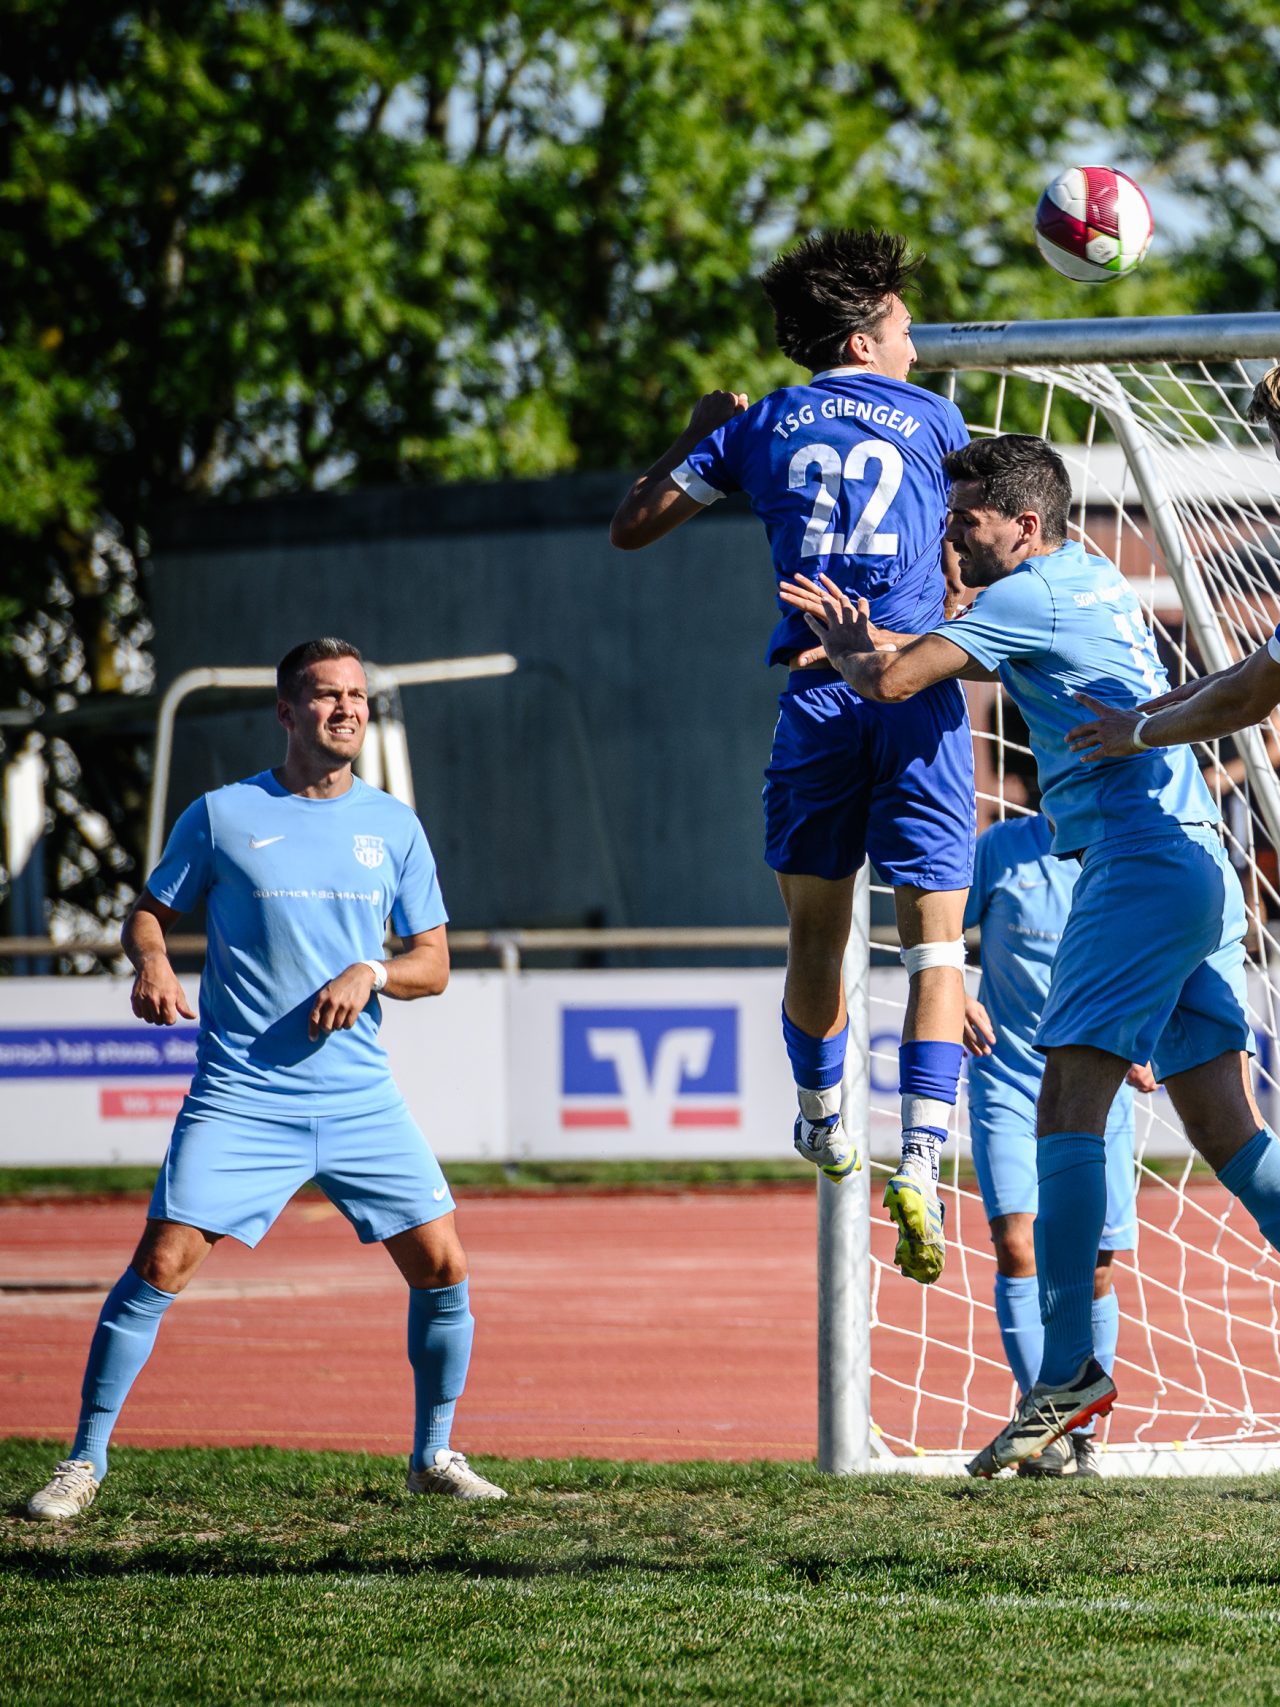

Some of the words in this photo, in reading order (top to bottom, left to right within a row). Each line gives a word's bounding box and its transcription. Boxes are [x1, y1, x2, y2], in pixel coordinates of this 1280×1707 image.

[773, 405, 815, 439] TSG
[821, 398, 920, 438] GIENGEN
[788, 439, 904, 558] 22
